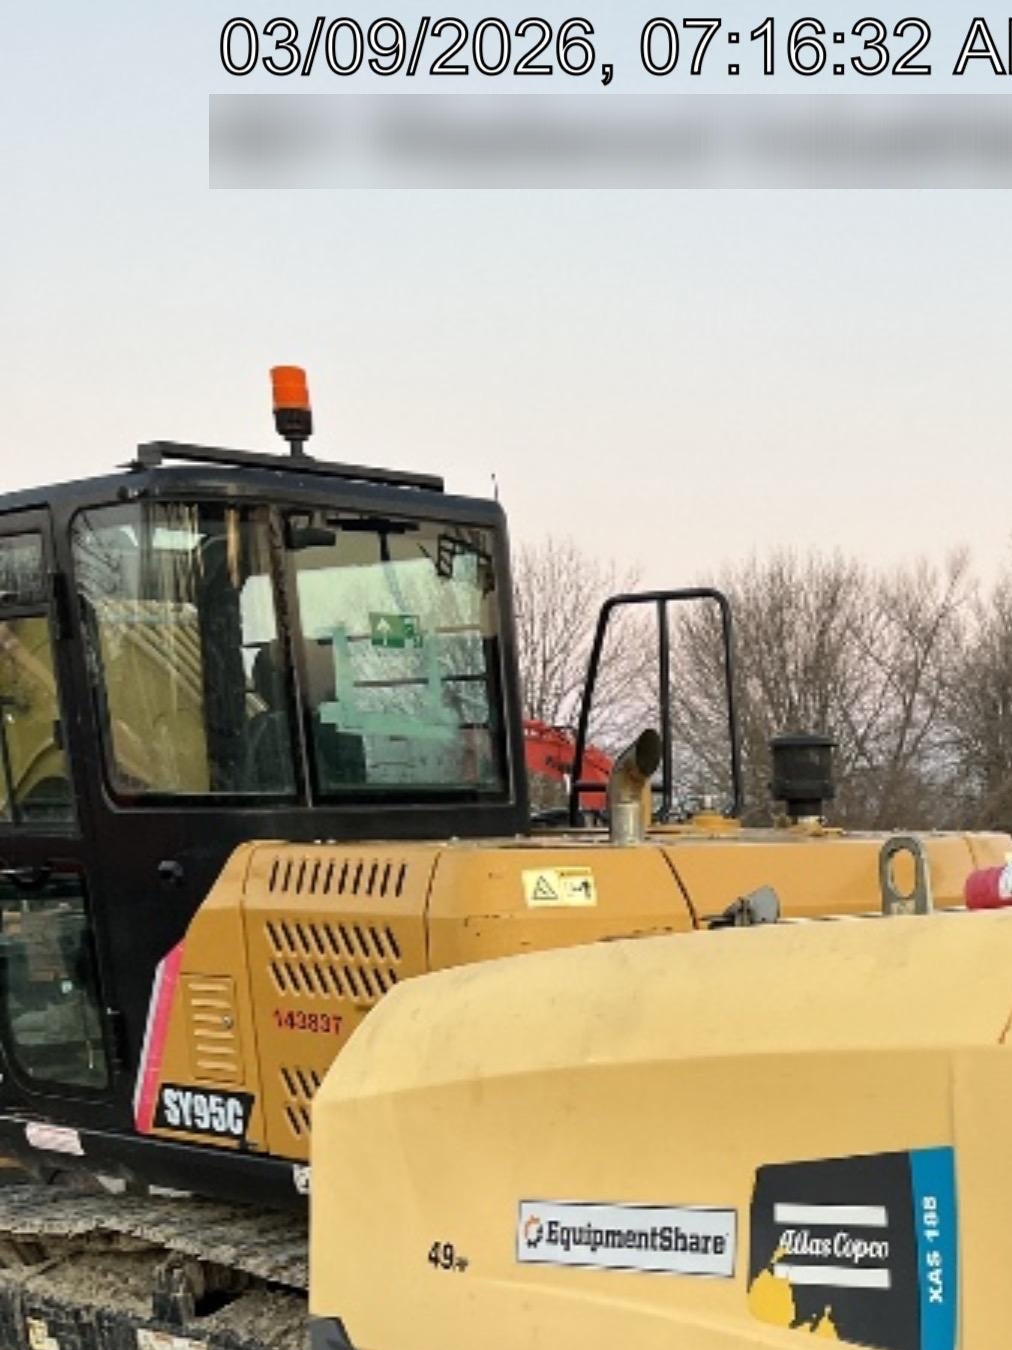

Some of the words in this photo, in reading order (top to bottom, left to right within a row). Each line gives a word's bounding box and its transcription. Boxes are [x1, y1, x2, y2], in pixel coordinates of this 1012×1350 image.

[163, 1087, 244, 1135] SY95C
[546, 1220, 727, 1255] EquipmentShare
[780, 1229, 832, 1257] Atlas
[833, 1231, 889, 1264] Copco
[926, 1250, 944, 1304] XAS
